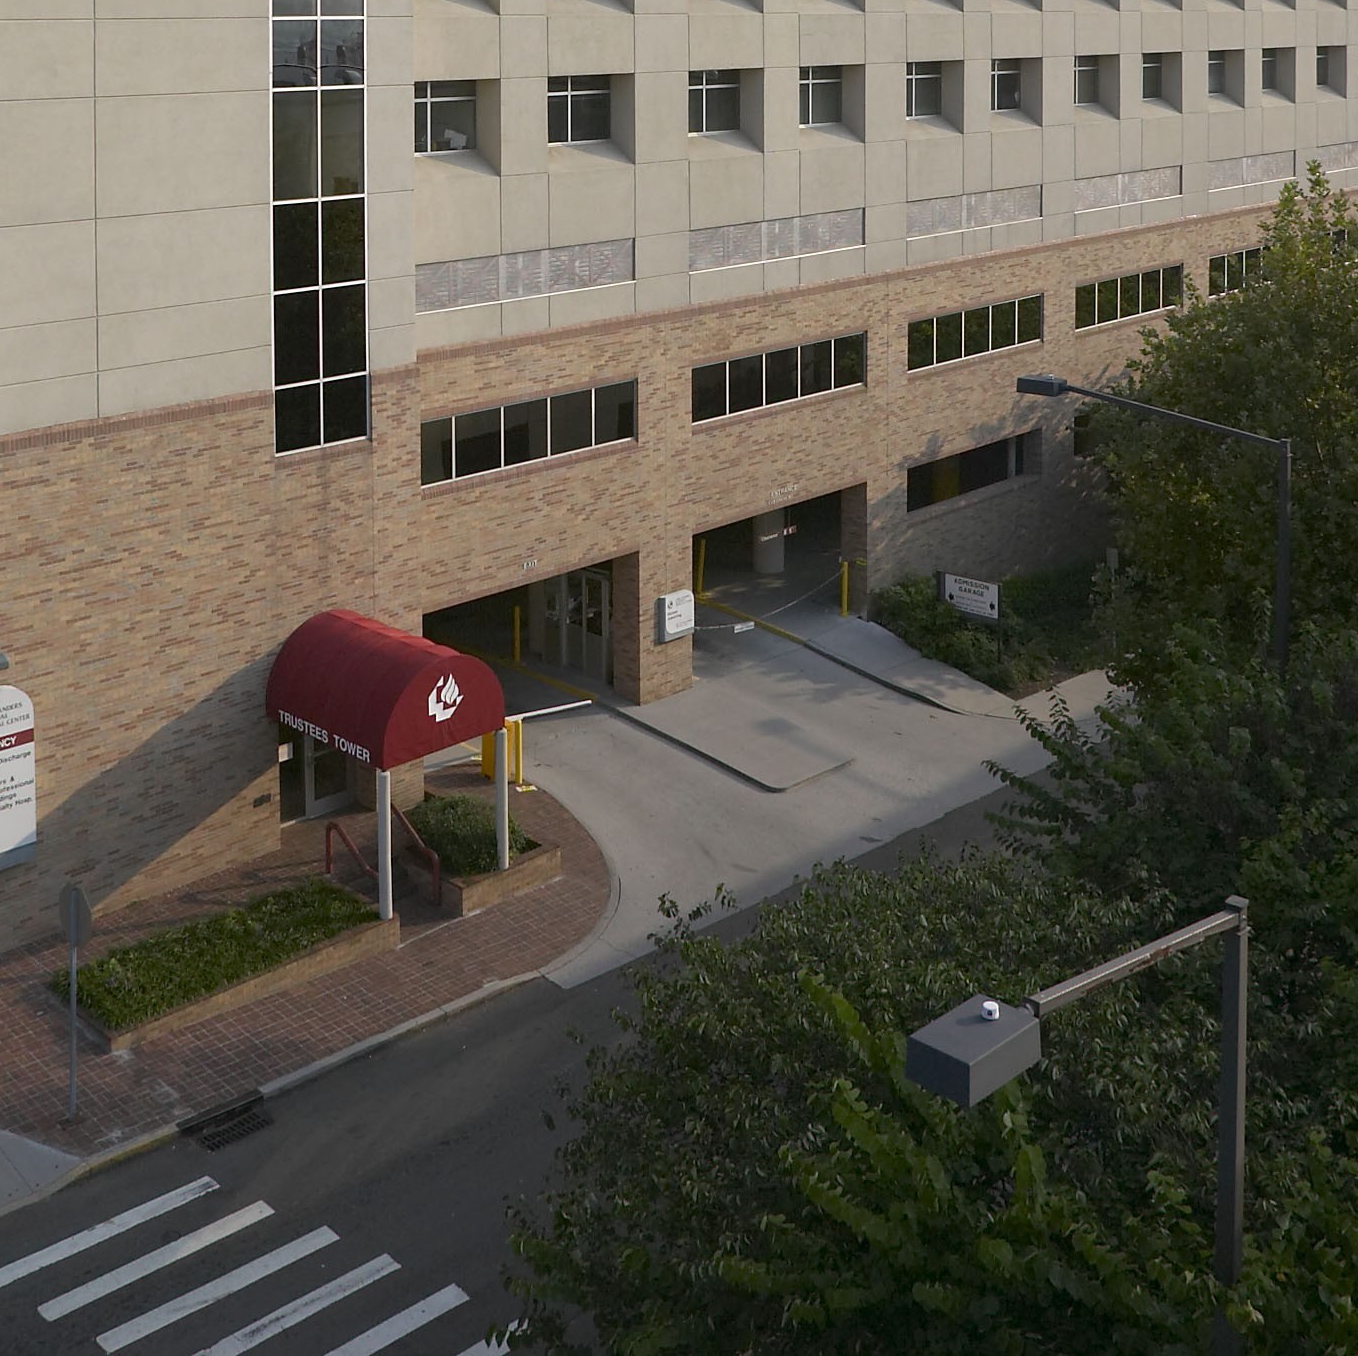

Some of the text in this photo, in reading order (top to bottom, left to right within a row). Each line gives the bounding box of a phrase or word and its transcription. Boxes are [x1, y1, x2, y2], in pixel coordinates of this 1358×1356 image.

[954, 578, 990, 591] ADMISSION
[958, 586, 984, 597] GARAGE
[6, 713, 31, 725] CENTER
[278, 709, 371, 763] TRUSTEES TOWER
